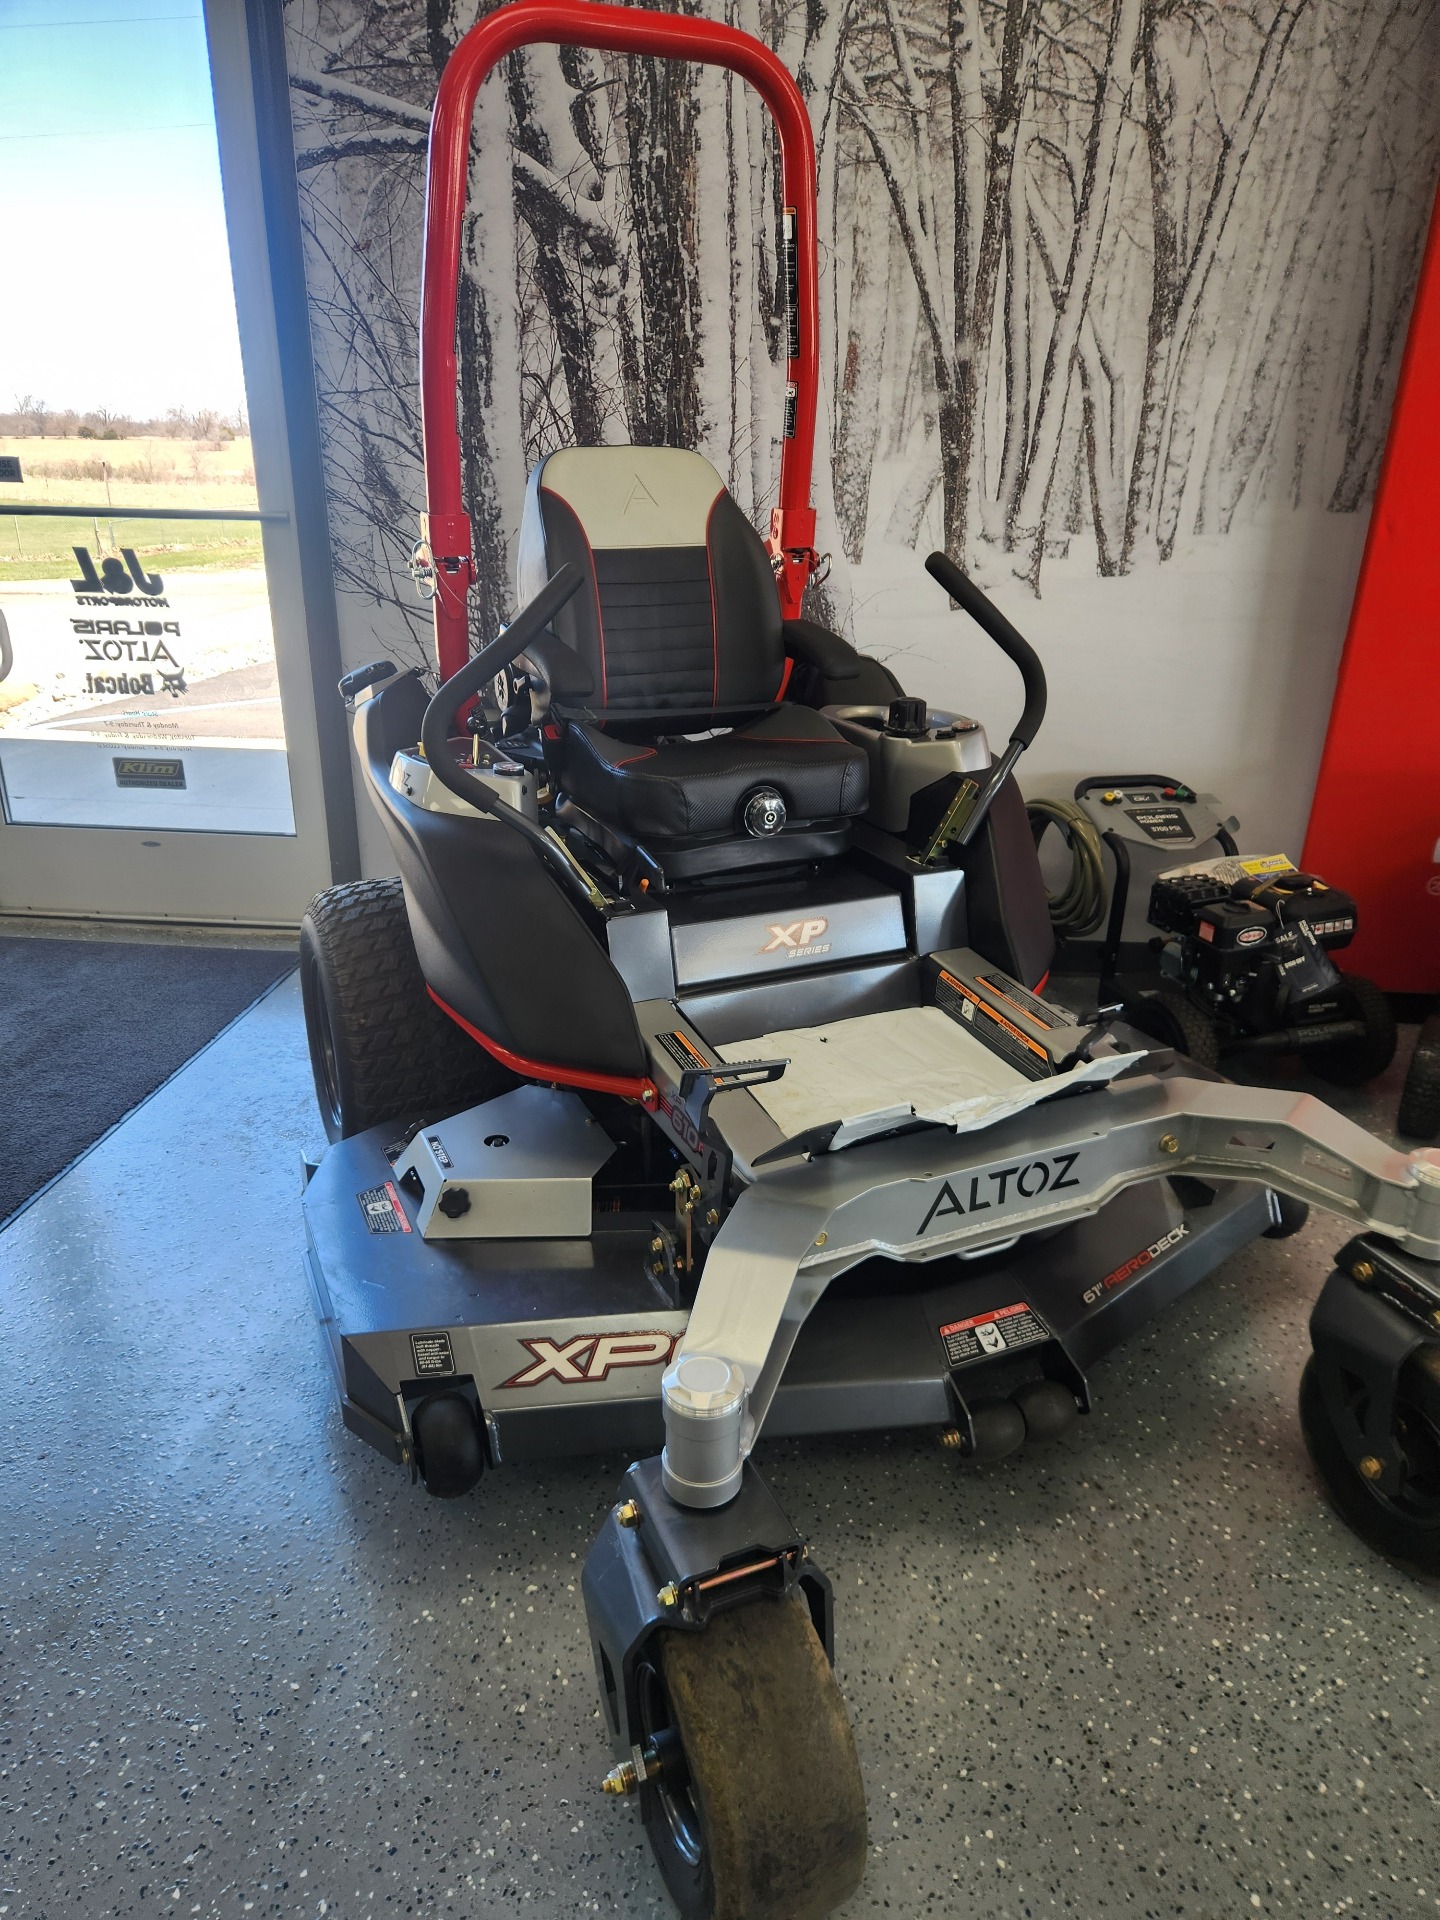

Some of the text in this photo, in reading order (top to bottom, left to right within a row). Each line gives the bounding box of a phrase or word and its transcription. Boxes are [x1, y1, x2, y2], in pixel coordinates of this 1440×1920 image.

[121, 762, 176, 775] Klim
[1136, 813, 1179, 821] POLARIS
[759, 917, 829, 954] XP
[1275, 930, 1293, 944] SALE
[788, 943, 831, 958] SERIES
[431, 1141, 449, 1163] NO STEP
[916, 1152, 1080, 1235] ALTOZ
[1083, 1223, 1190, 1304] 61" AERODECK
[949, 1304, 1023, 1331] DANGER PELIGRO
[495, 1329, 687, 1390] XP
